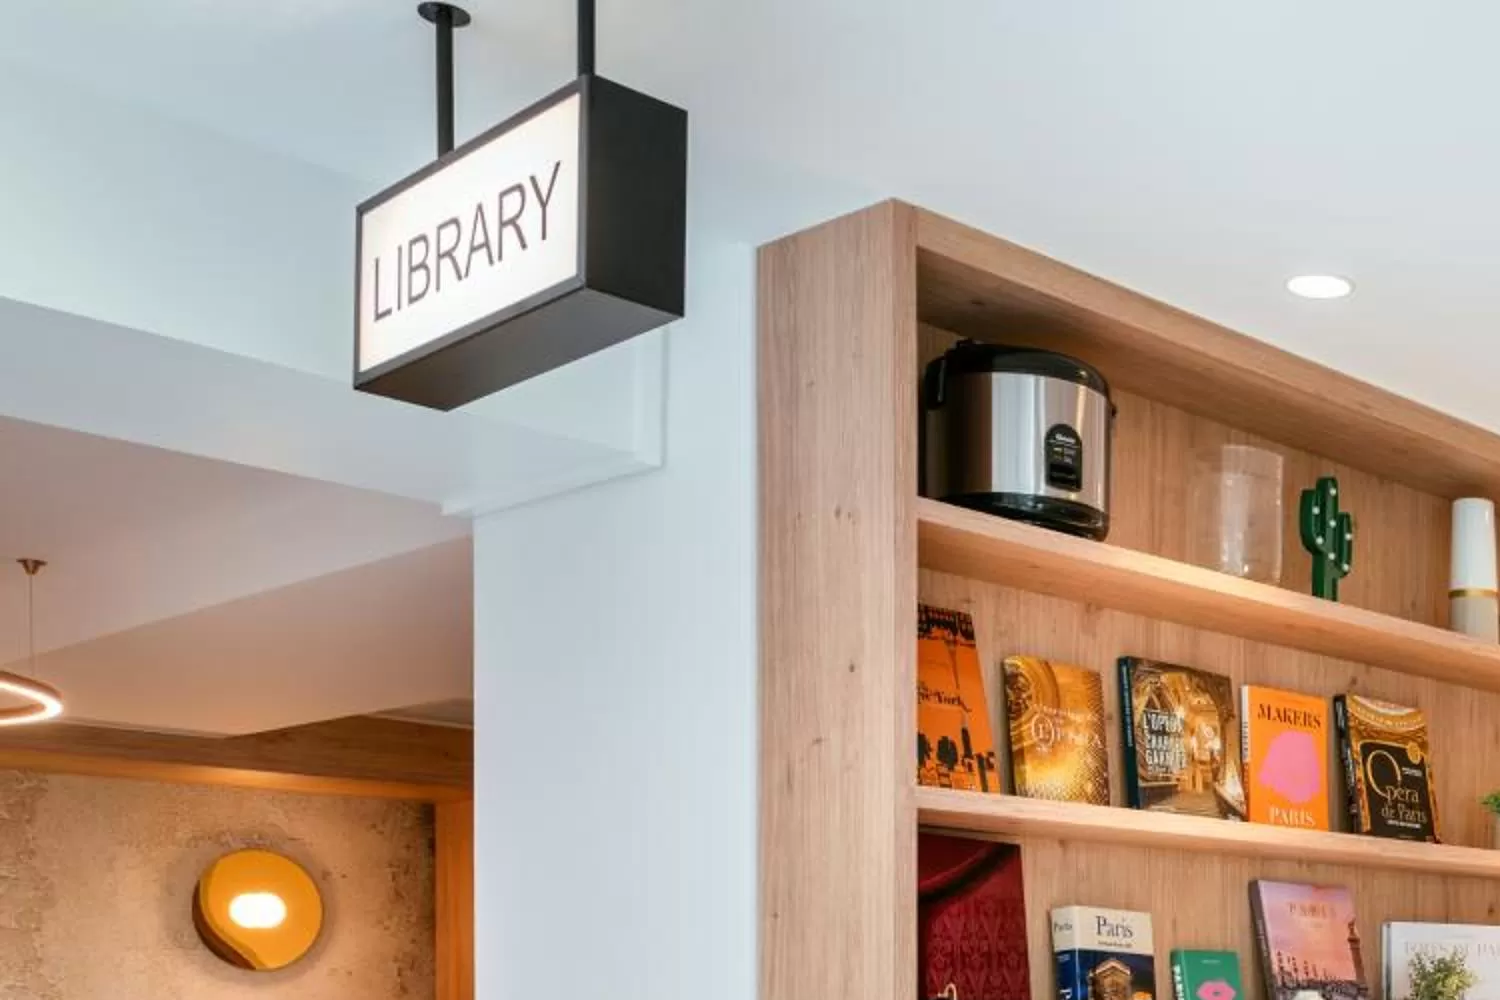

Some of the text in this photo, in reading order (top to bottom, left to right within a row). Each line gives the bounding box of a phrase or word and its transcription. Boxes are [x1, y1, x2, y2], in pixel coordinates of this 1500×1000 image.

[373, 160, 562, 322] LIBRARY
[1257, 704, 1321, 729] MAKERS
[1269, 807, 1316, 827] PARIS
[1096, 915, 1133, 938] Paris
